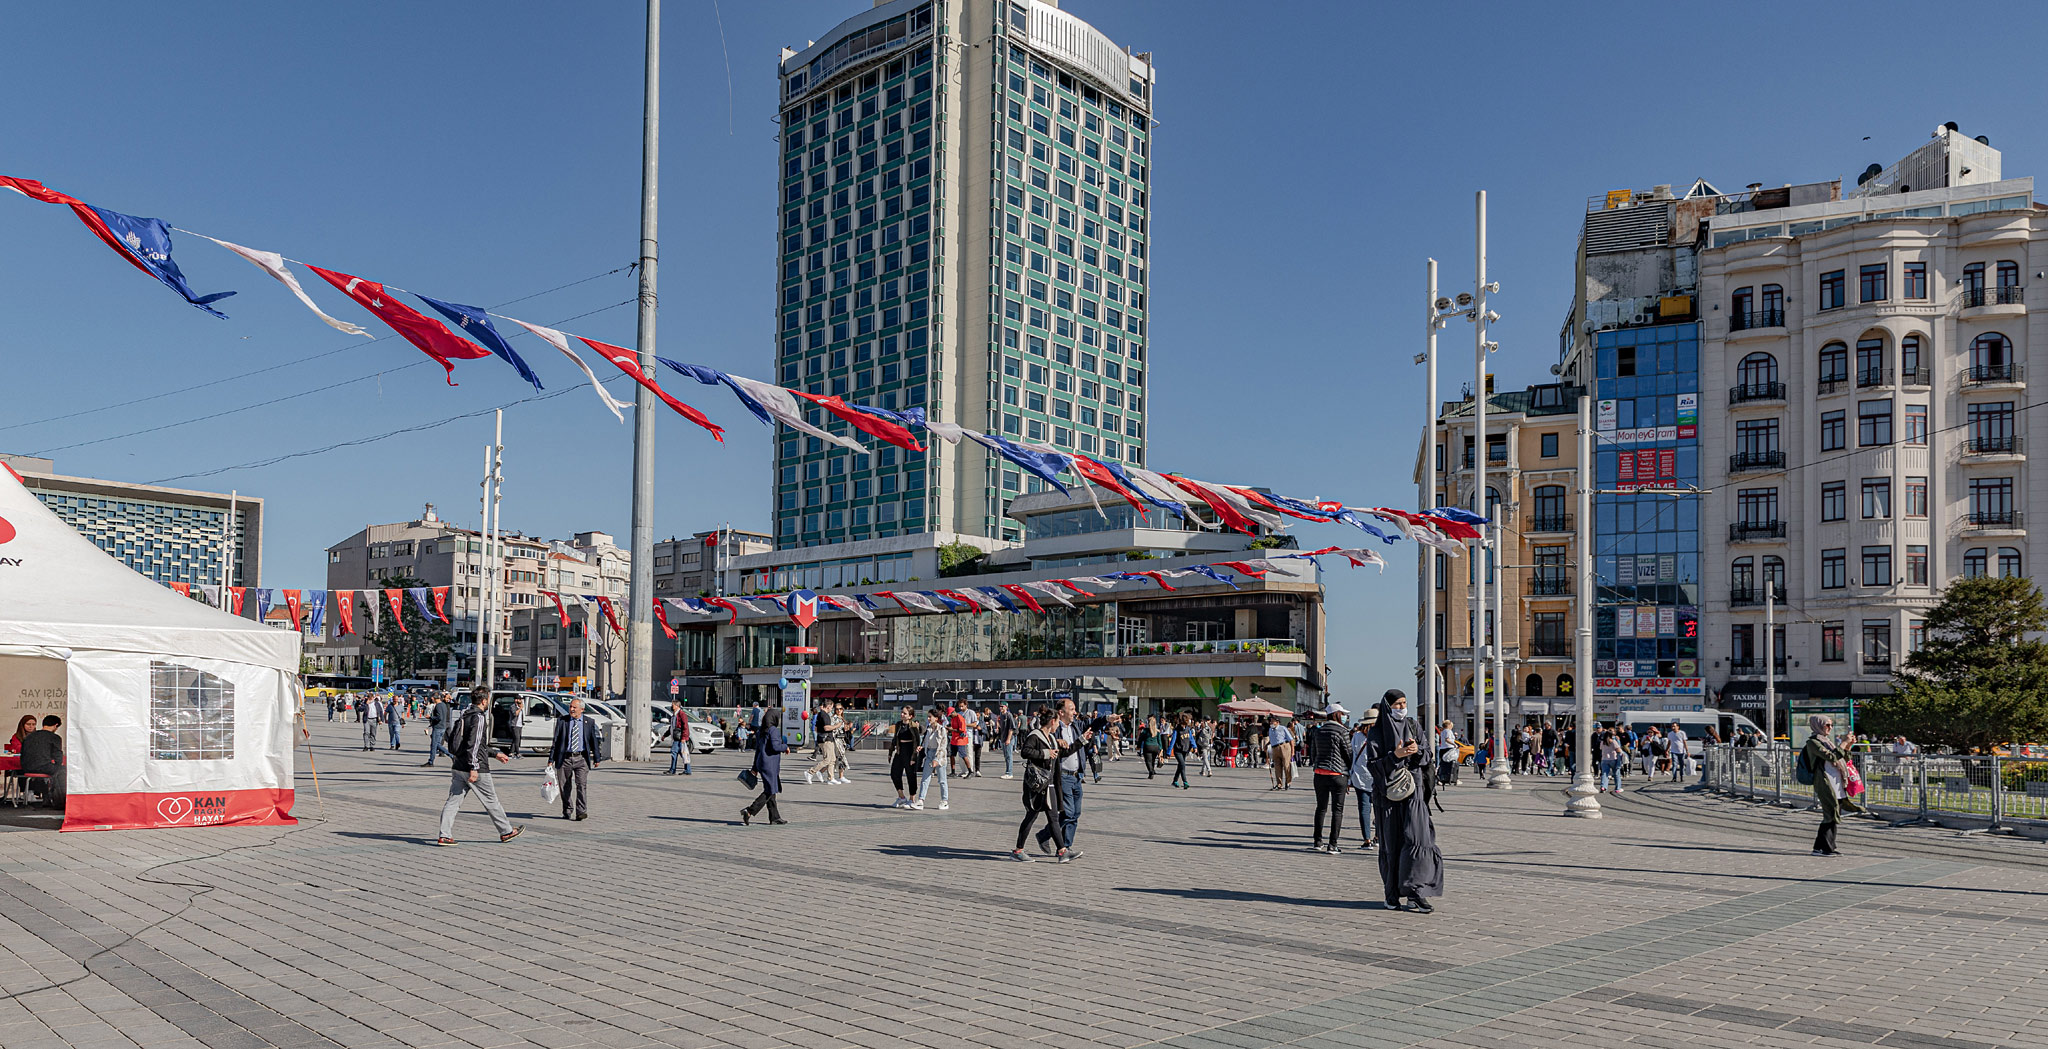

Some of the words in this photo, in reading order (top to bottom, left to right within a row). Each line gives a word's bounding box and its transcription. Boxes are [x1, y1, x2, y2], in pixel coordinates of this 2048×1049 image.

[1617, 429, 1676, 441] MoneyGram
[1596, 678, 1622, 688] HOP
[1624, 678, 1644, 688] ON
[1646, 678, 1673, 688] HOP
[1674, 678, 1702, 688] OFF
[1619, 698, 1650, 706] CHANGE
[195, 797, 225, 807] KAN
